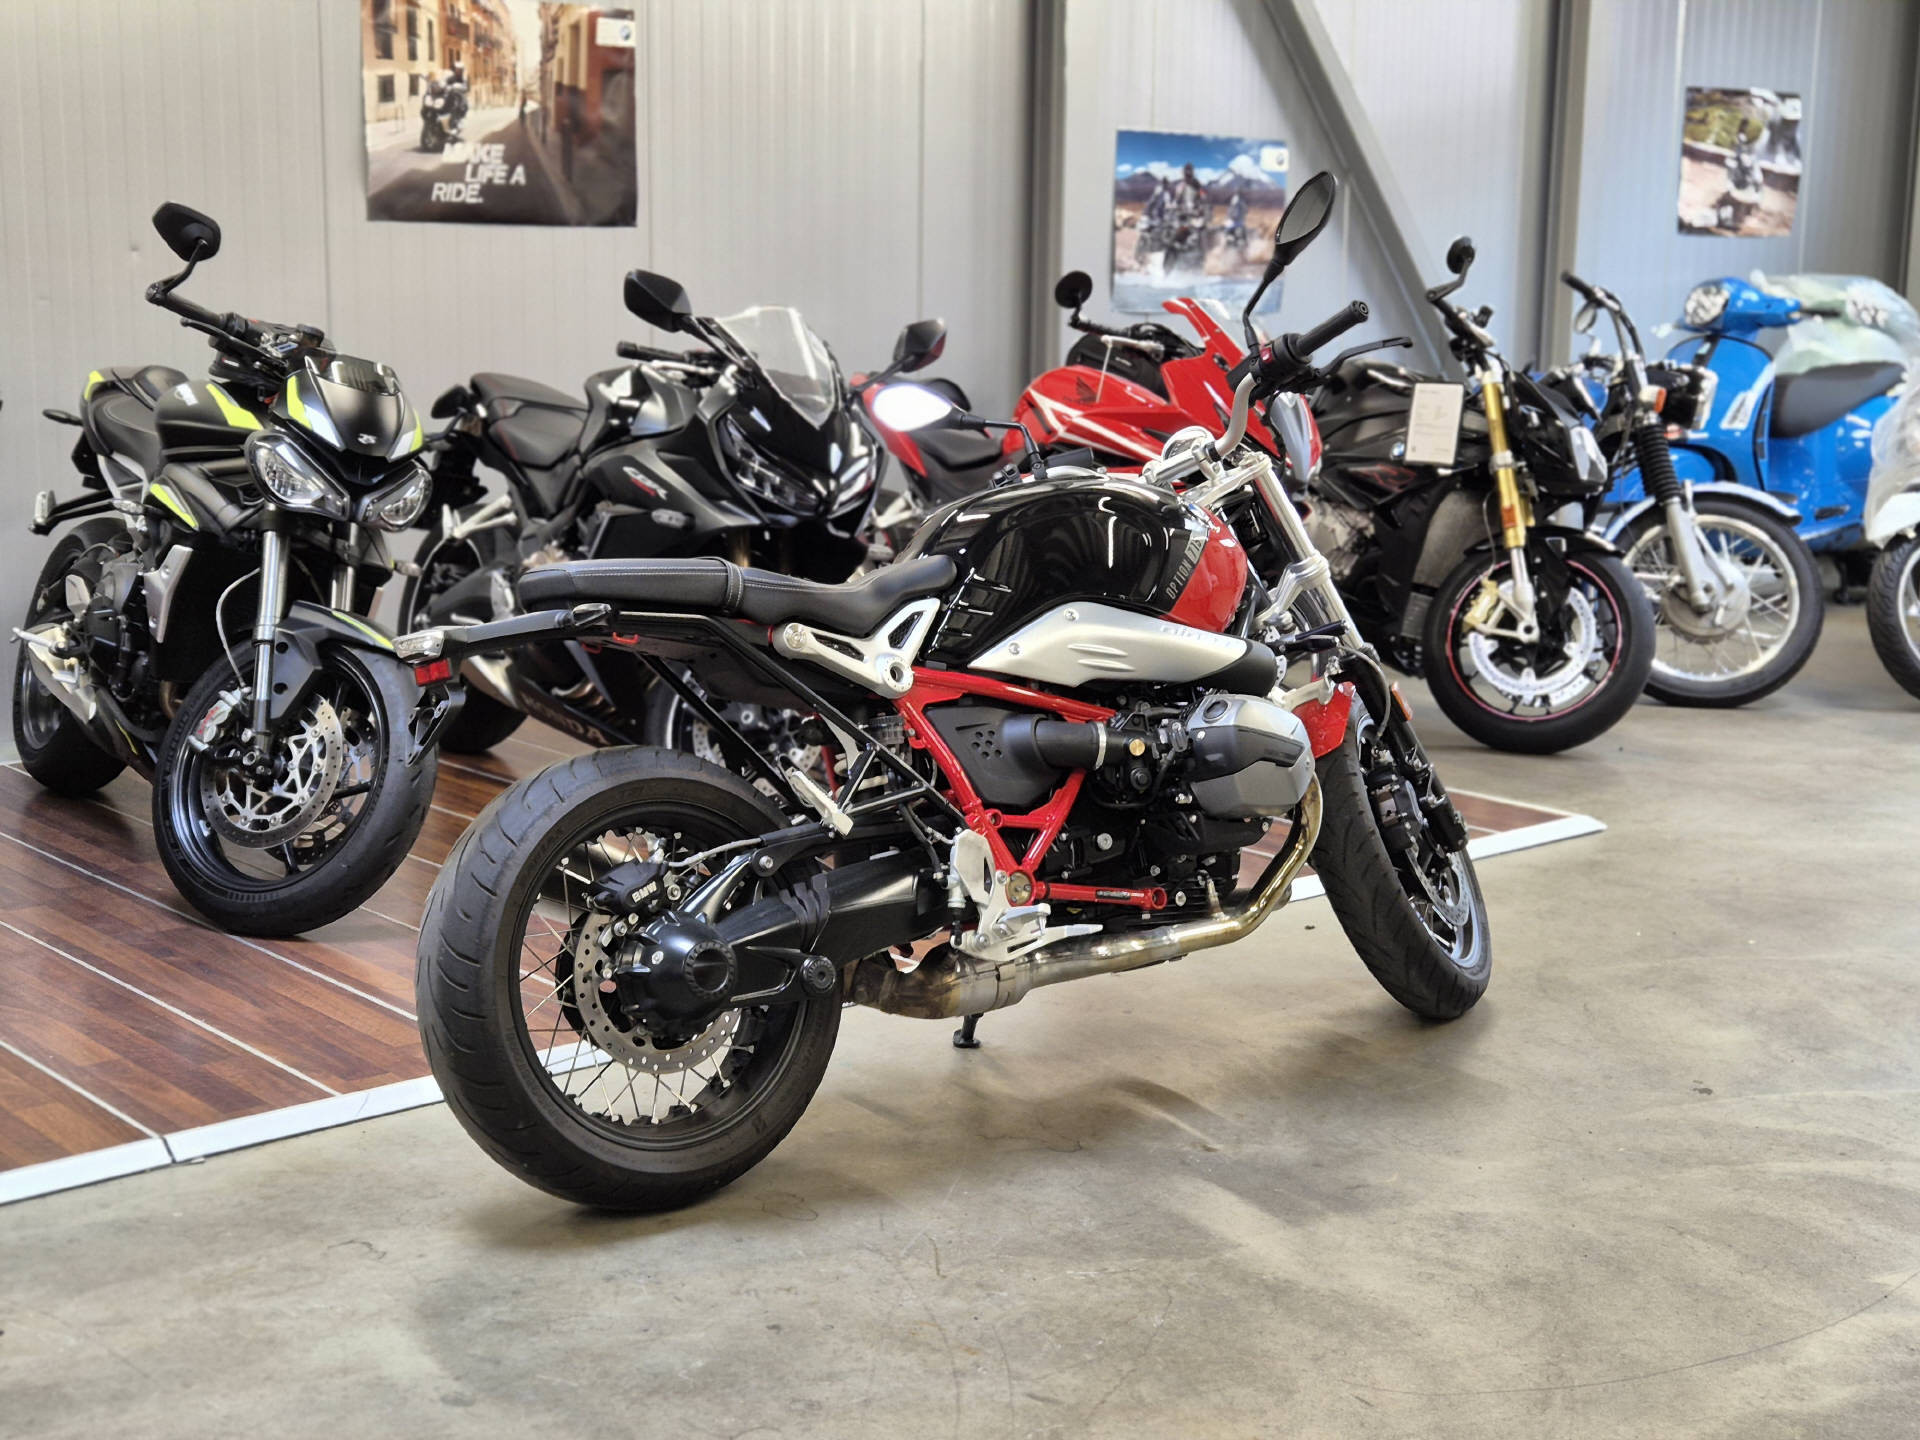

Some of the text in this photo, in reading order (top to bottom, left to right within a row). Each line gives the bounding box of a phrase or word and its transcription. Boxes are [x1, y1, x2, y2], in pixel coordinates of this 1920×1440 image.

[465, 163, 526, 185] LIFE A
[431, 182, 483, 203] RIDE.
[1165, 559, 1193, 600] OPTION
[632, 880, 657, 903] BMW
